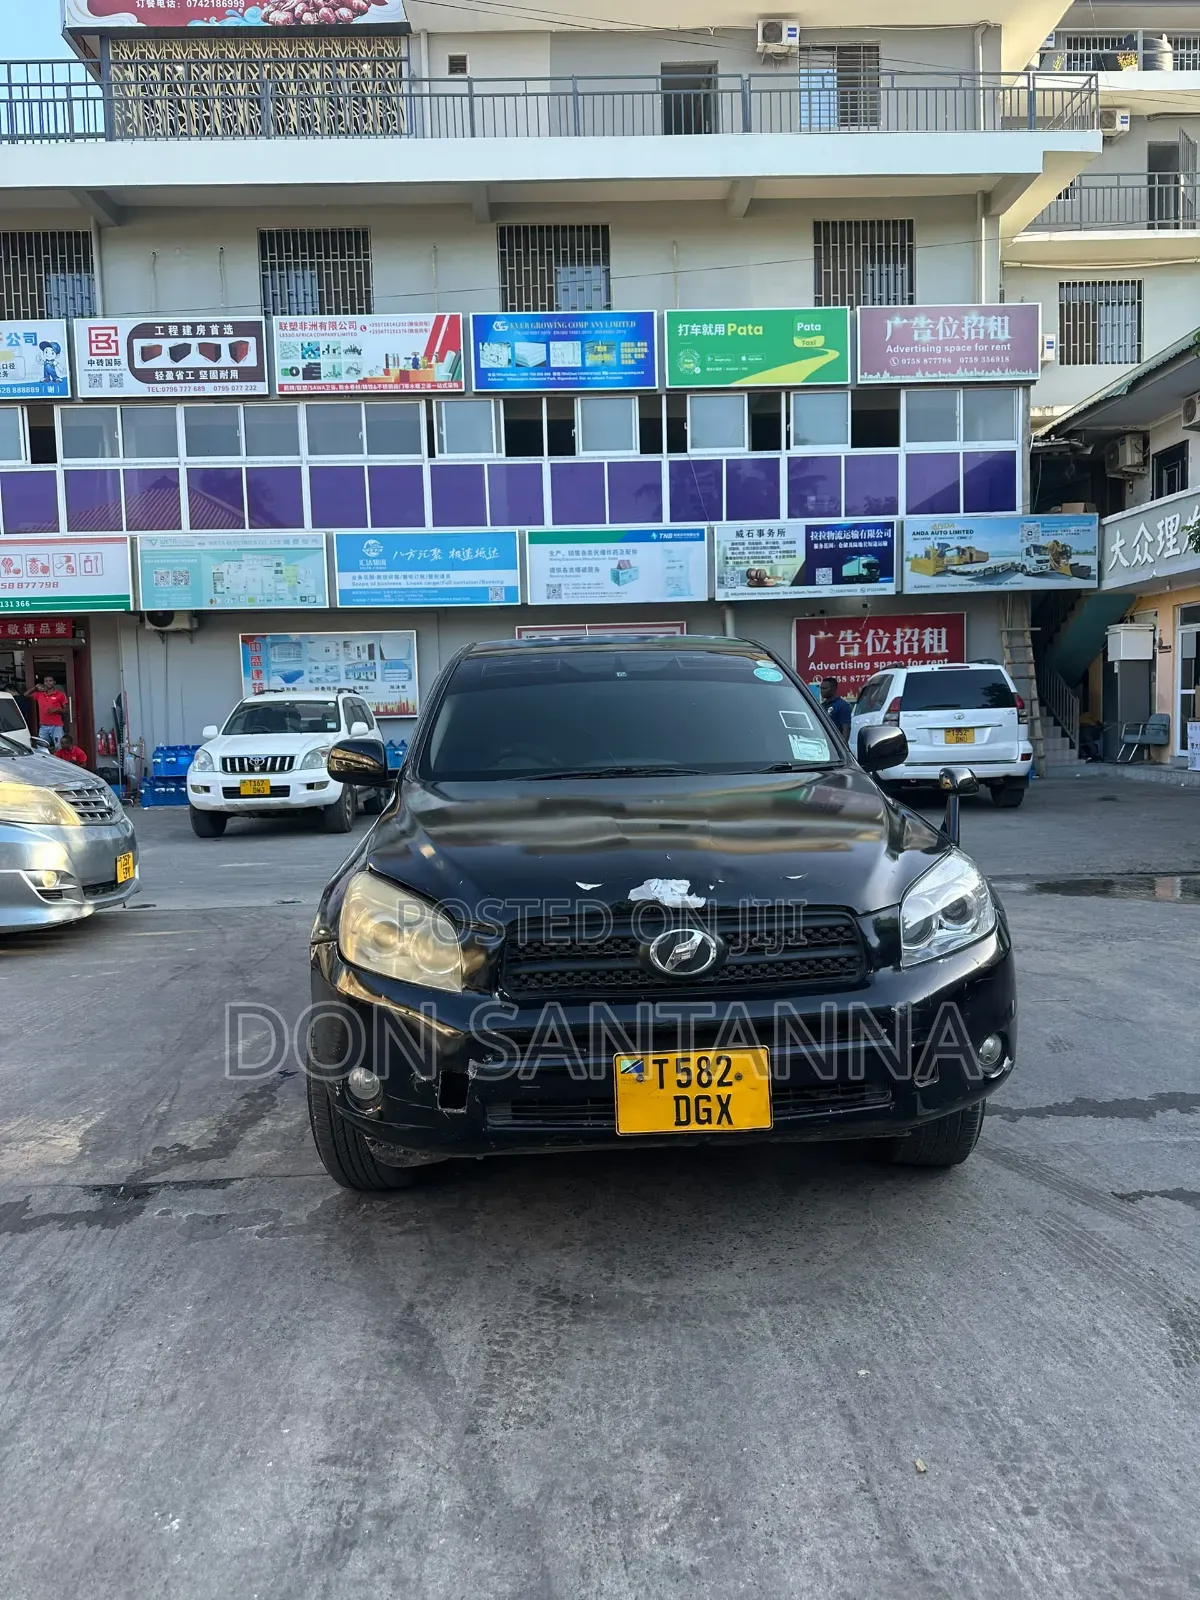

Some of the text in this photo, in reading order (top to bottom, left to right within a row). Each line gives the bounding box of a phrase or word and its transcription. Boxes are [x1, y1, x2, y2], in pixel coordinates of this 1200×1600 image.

[154, 324, 234, 336] 工程建房首选
[278, 321, 357, 331] 联塑非洲有限公司
[530, 321, 567, 329] GROWING
[605, 320, 636, 328] LIMITED
[677, 323, 763, 337] 打车就用 Pata
[797, 322, 822, 332] Pata
[885, 314, 1011, 342] 广告位招租
[0, 332, 38, 346] 公司
[885, 345, 942, 354] Advertising
[944, 345, 973, 354] space
[974, 343, 989, 351] for
[87, 358, 122, 367] 中砖国际
[959, 356, 979, 364] 0759
[154, 369, 239, 381] 轻盈省工 坚固耐用
[735, 528, 787, 538] 威石事务所
[810, 528, 892, 541] 拉拉物流运输有限公司
[808, 626, 949, 659] 广告位招租
[808, 660, 870, 671] Advertising
[906, 657, 924, 667] for
[925, 657, 949, 665] rent
[652, 1055, 733, 1089] T 582
[673, 1093, 734, 1127] DGX
